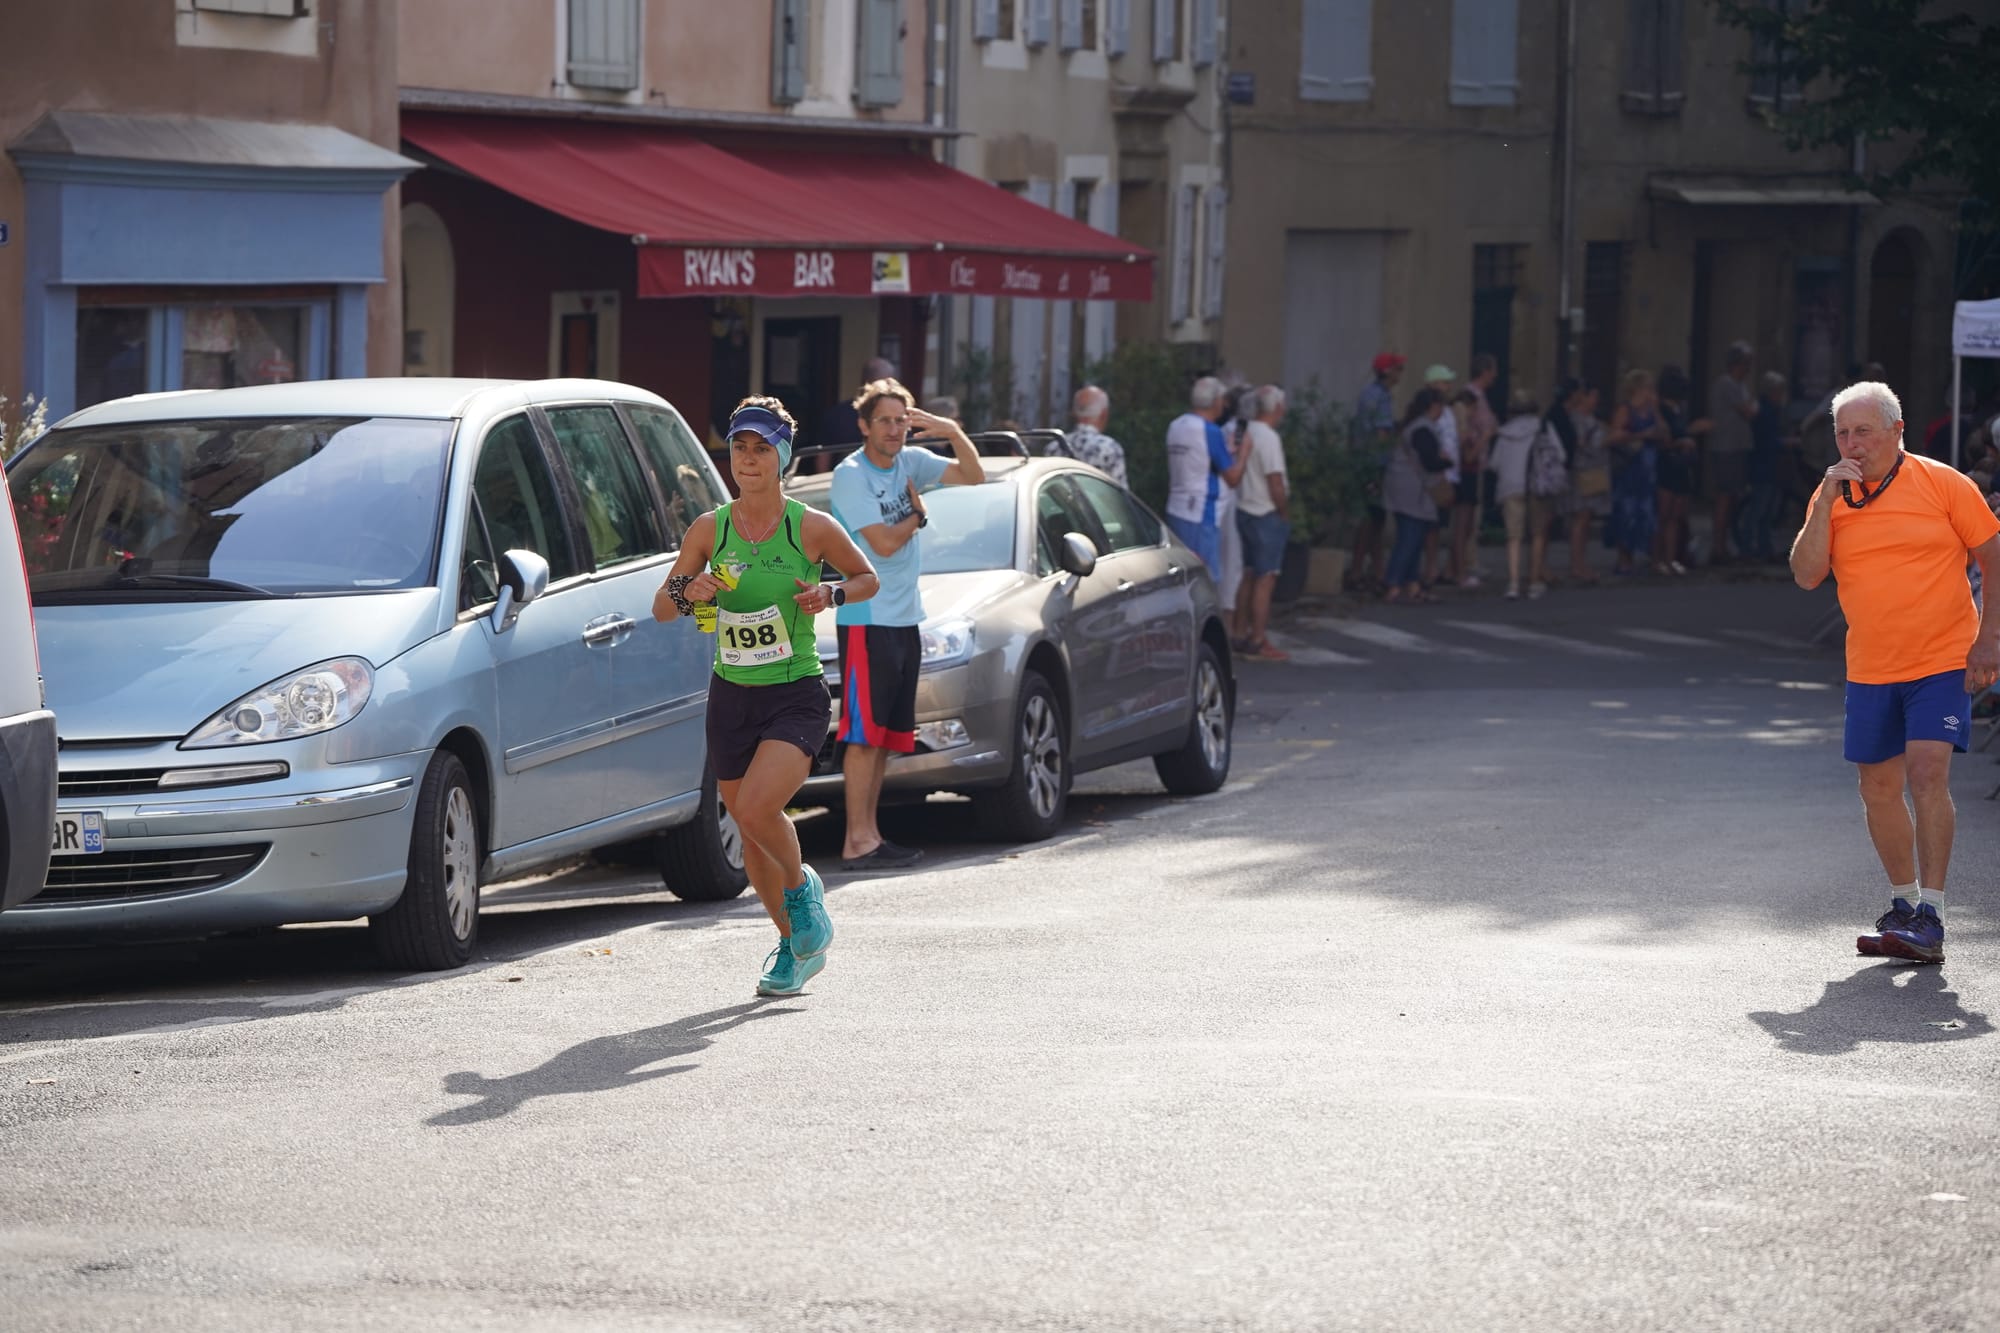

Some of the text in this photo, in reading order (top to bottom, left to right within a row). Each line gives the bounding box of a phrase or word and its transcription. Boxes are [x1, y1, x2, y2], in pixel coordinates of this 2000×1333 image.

[684, 249, 834, 287] RYAN'S BAR
[725, 624, 777, 648] 198
[85, 833, 101, 847] 59
